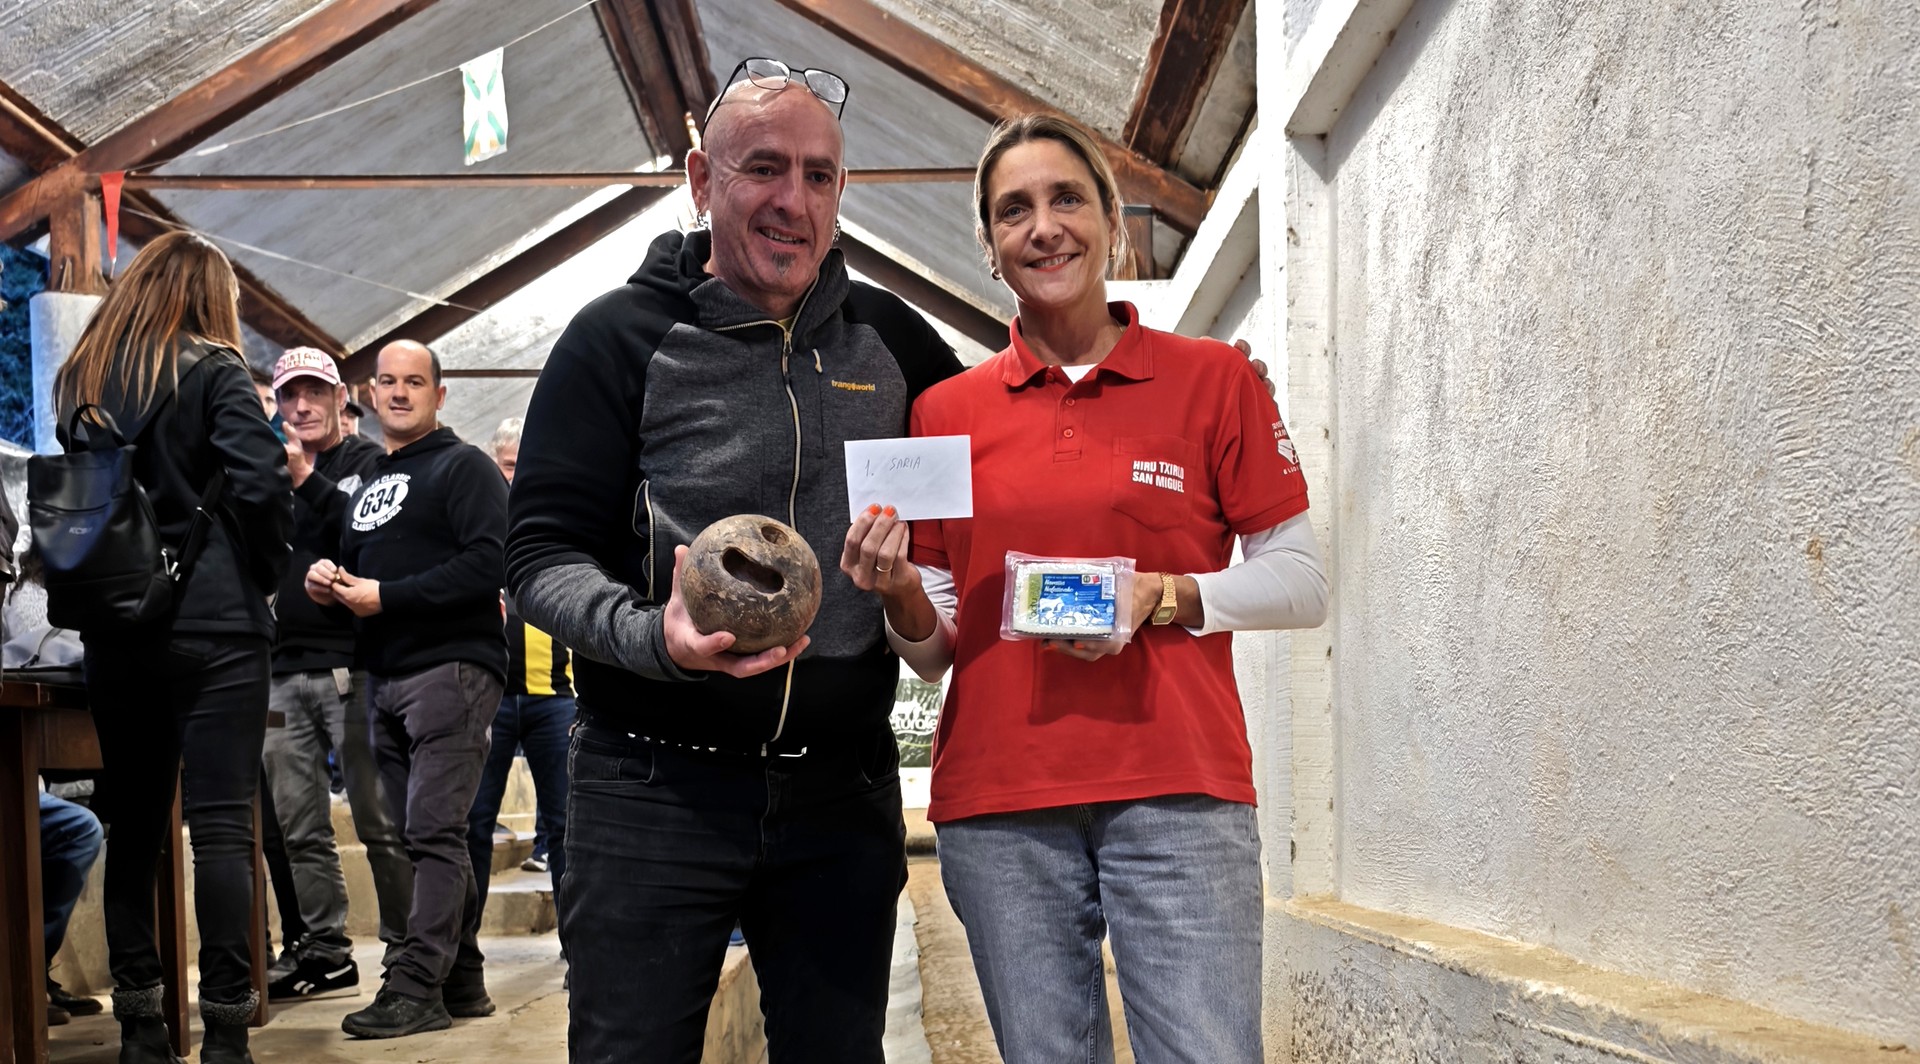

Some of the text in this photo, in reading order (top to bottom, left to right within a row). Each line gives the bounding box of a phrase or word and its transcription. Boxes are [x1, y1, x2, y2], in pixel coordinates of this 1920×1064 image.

[889, 457, 921, 471] SARIA
[1133, 460, 1157, 473] HIRU
[1132, 471, 1185, 493] SAN MIGUEL
[360, 483, 400, 518] 634
[352, 521, 376, 531] CLASSIC
